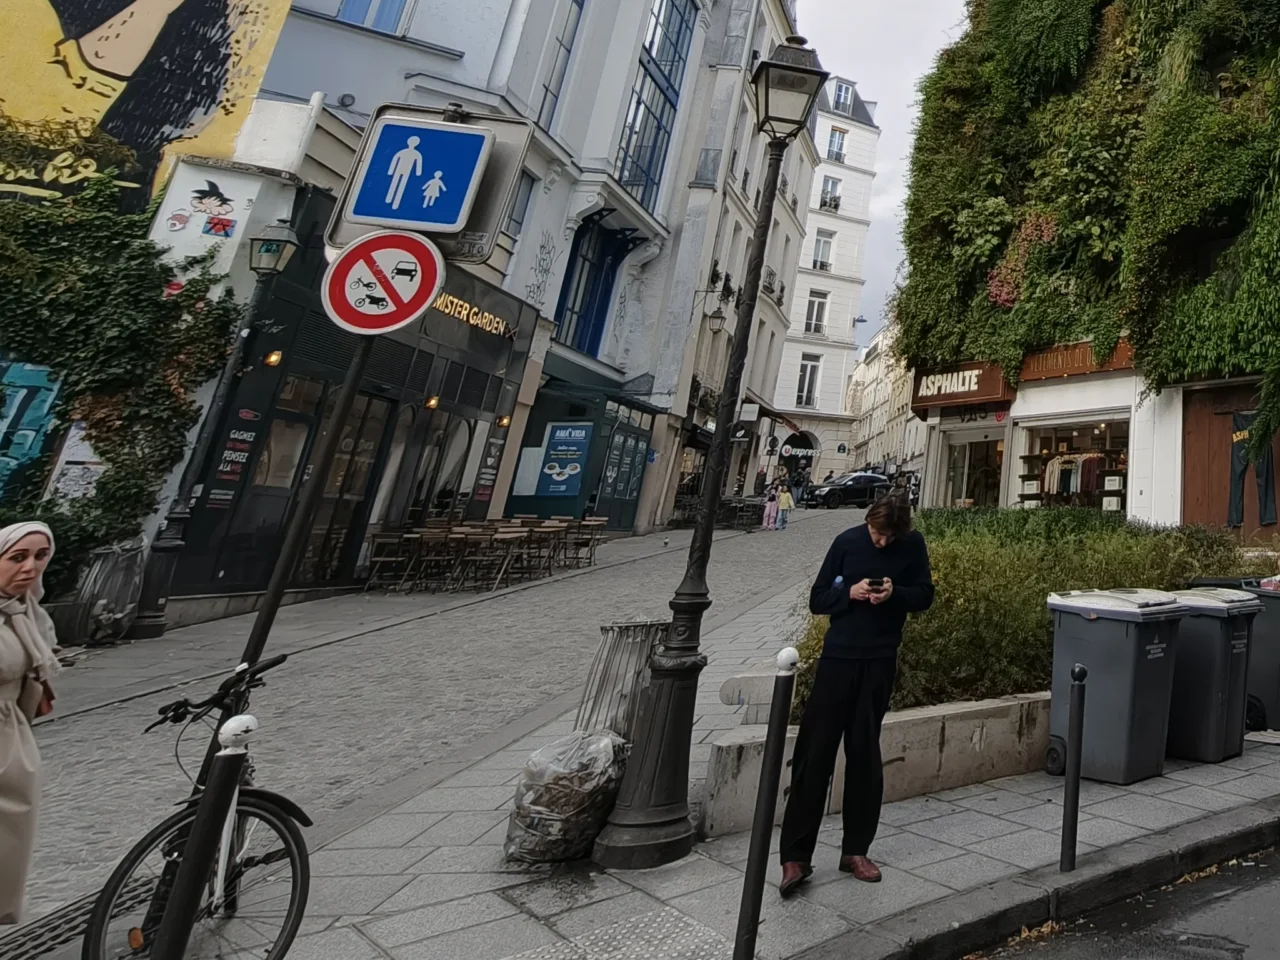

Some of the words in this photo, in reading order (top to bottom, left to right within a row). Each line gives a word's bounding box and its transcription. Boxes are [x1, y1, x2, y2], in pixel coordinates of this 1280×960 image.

[432, 292, 470, 322] MISTER
[469, 306, 507, 336] GARDEN
[1074, 348, 1083, 367] DE
[918, 368, 980, 398] ASPHALTE
[229, 429, 257, 441] GAGNEZ
[1232, 429, 1249, 443] ASPH
[222, 450, 250, 463] PENSEZ
[791, 448, 822, 458] express
